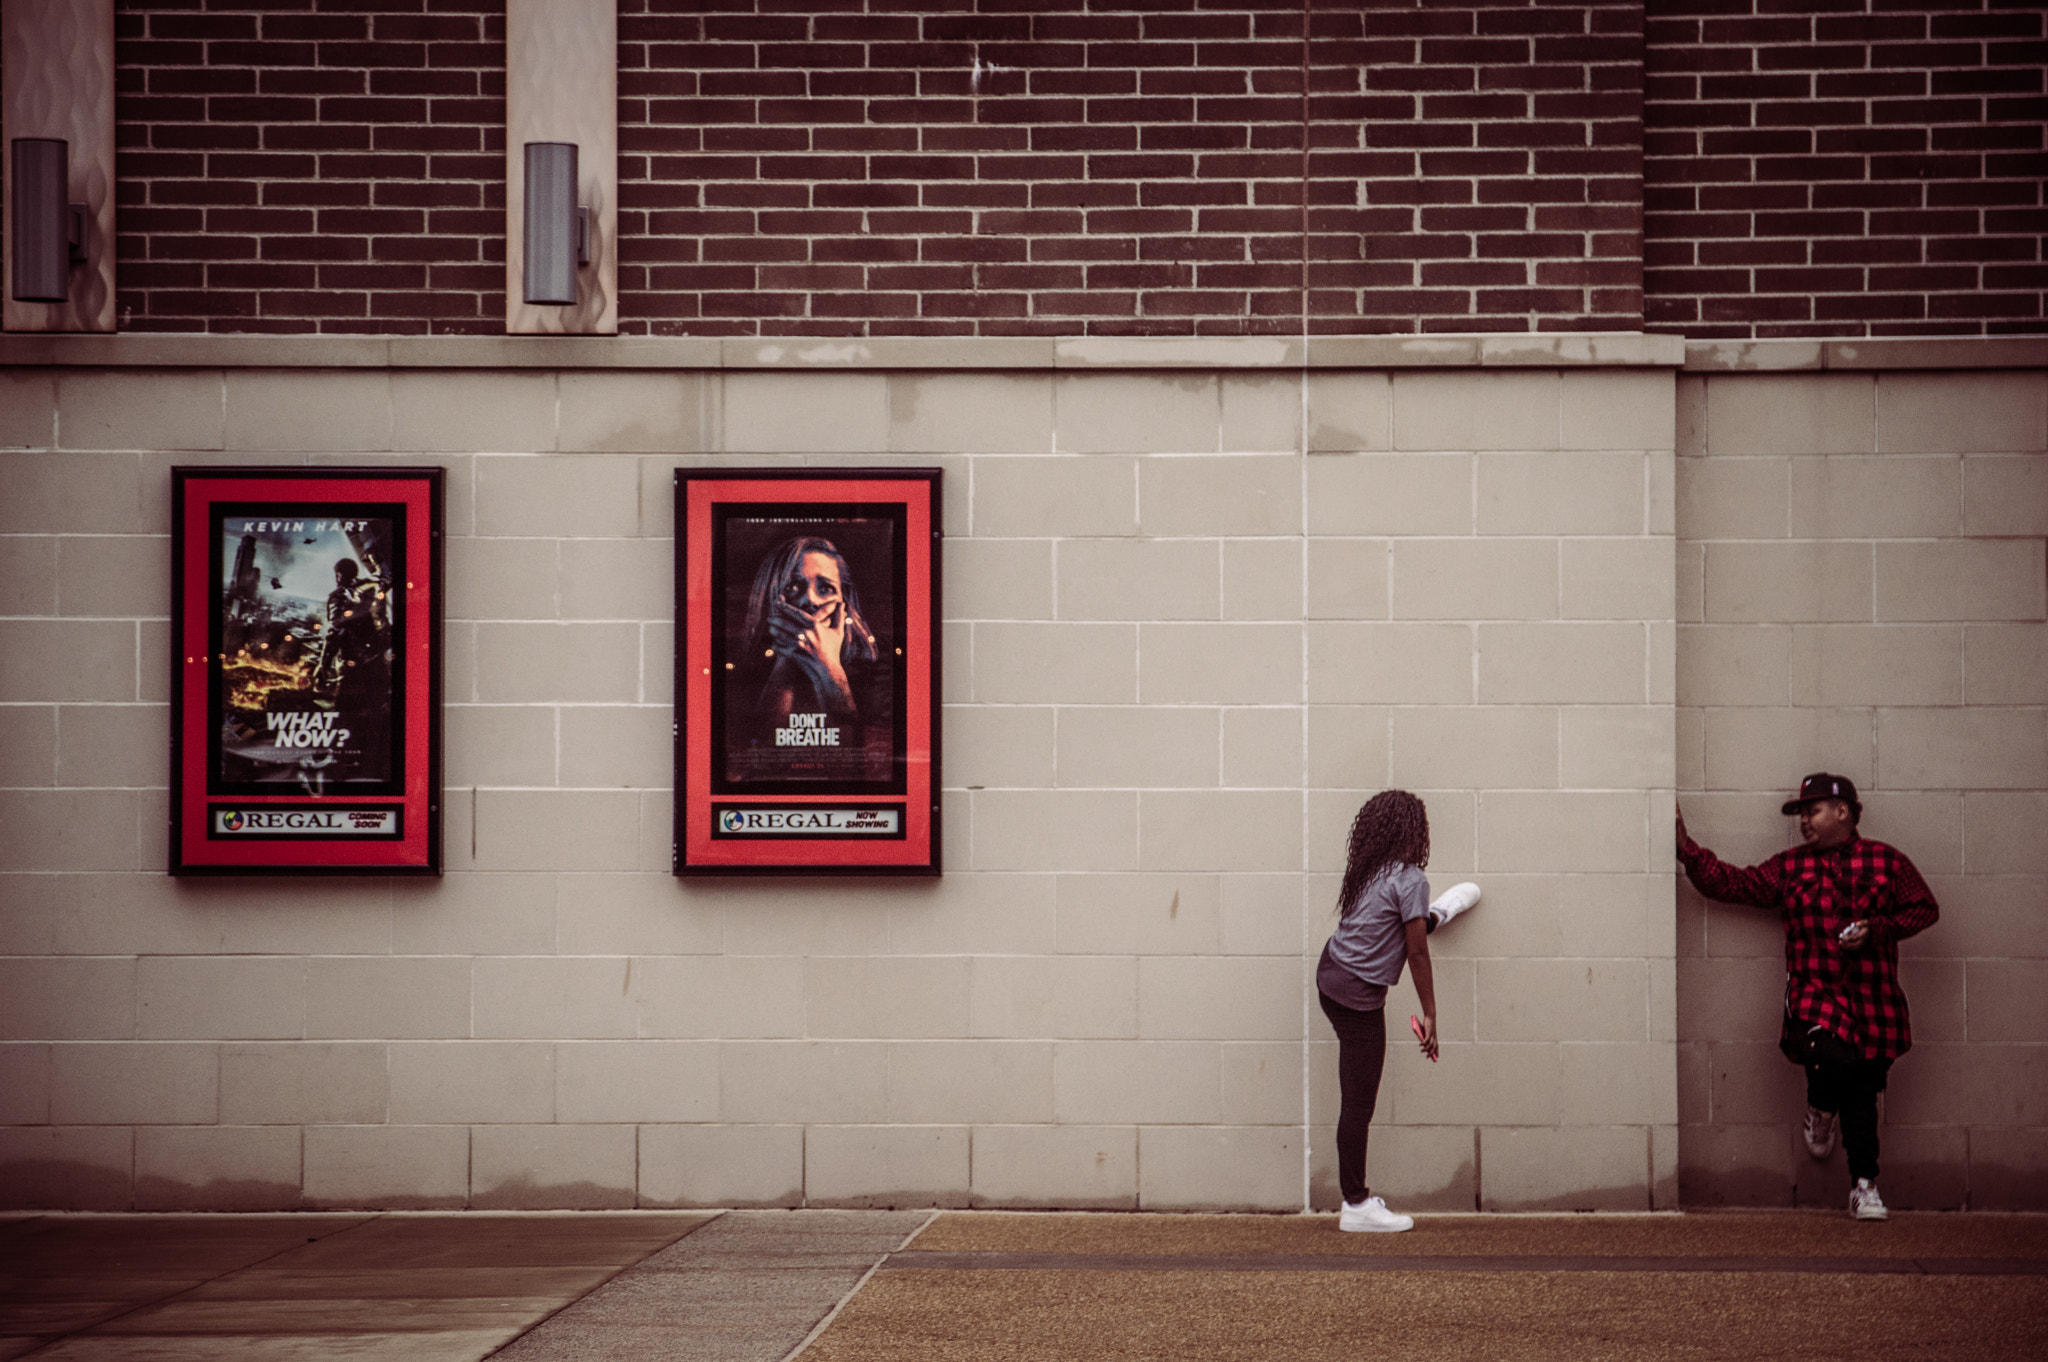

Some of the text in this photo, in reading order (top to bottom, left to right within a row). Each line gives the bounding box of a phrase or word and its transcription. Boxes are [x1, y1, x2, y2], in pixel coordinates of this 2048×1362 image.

[243, 521, 369, 532] KEVIN HART
[266, 711, 340, 731] WHAT
[789, 713, 827, 729] DON'T
[274, 728, 350, 748] NOW?
[775, 728, 840, 746] BREATHE
[246, 813, 342, 829] REGAL
[348, 812, 387, 821] COMING
[747, 813, 842, 829] REGAL
[855, 811, 879, 820] NOW
[353, 820, 381, 829] SOON
[845, 820, 889, 829] SHOWING
